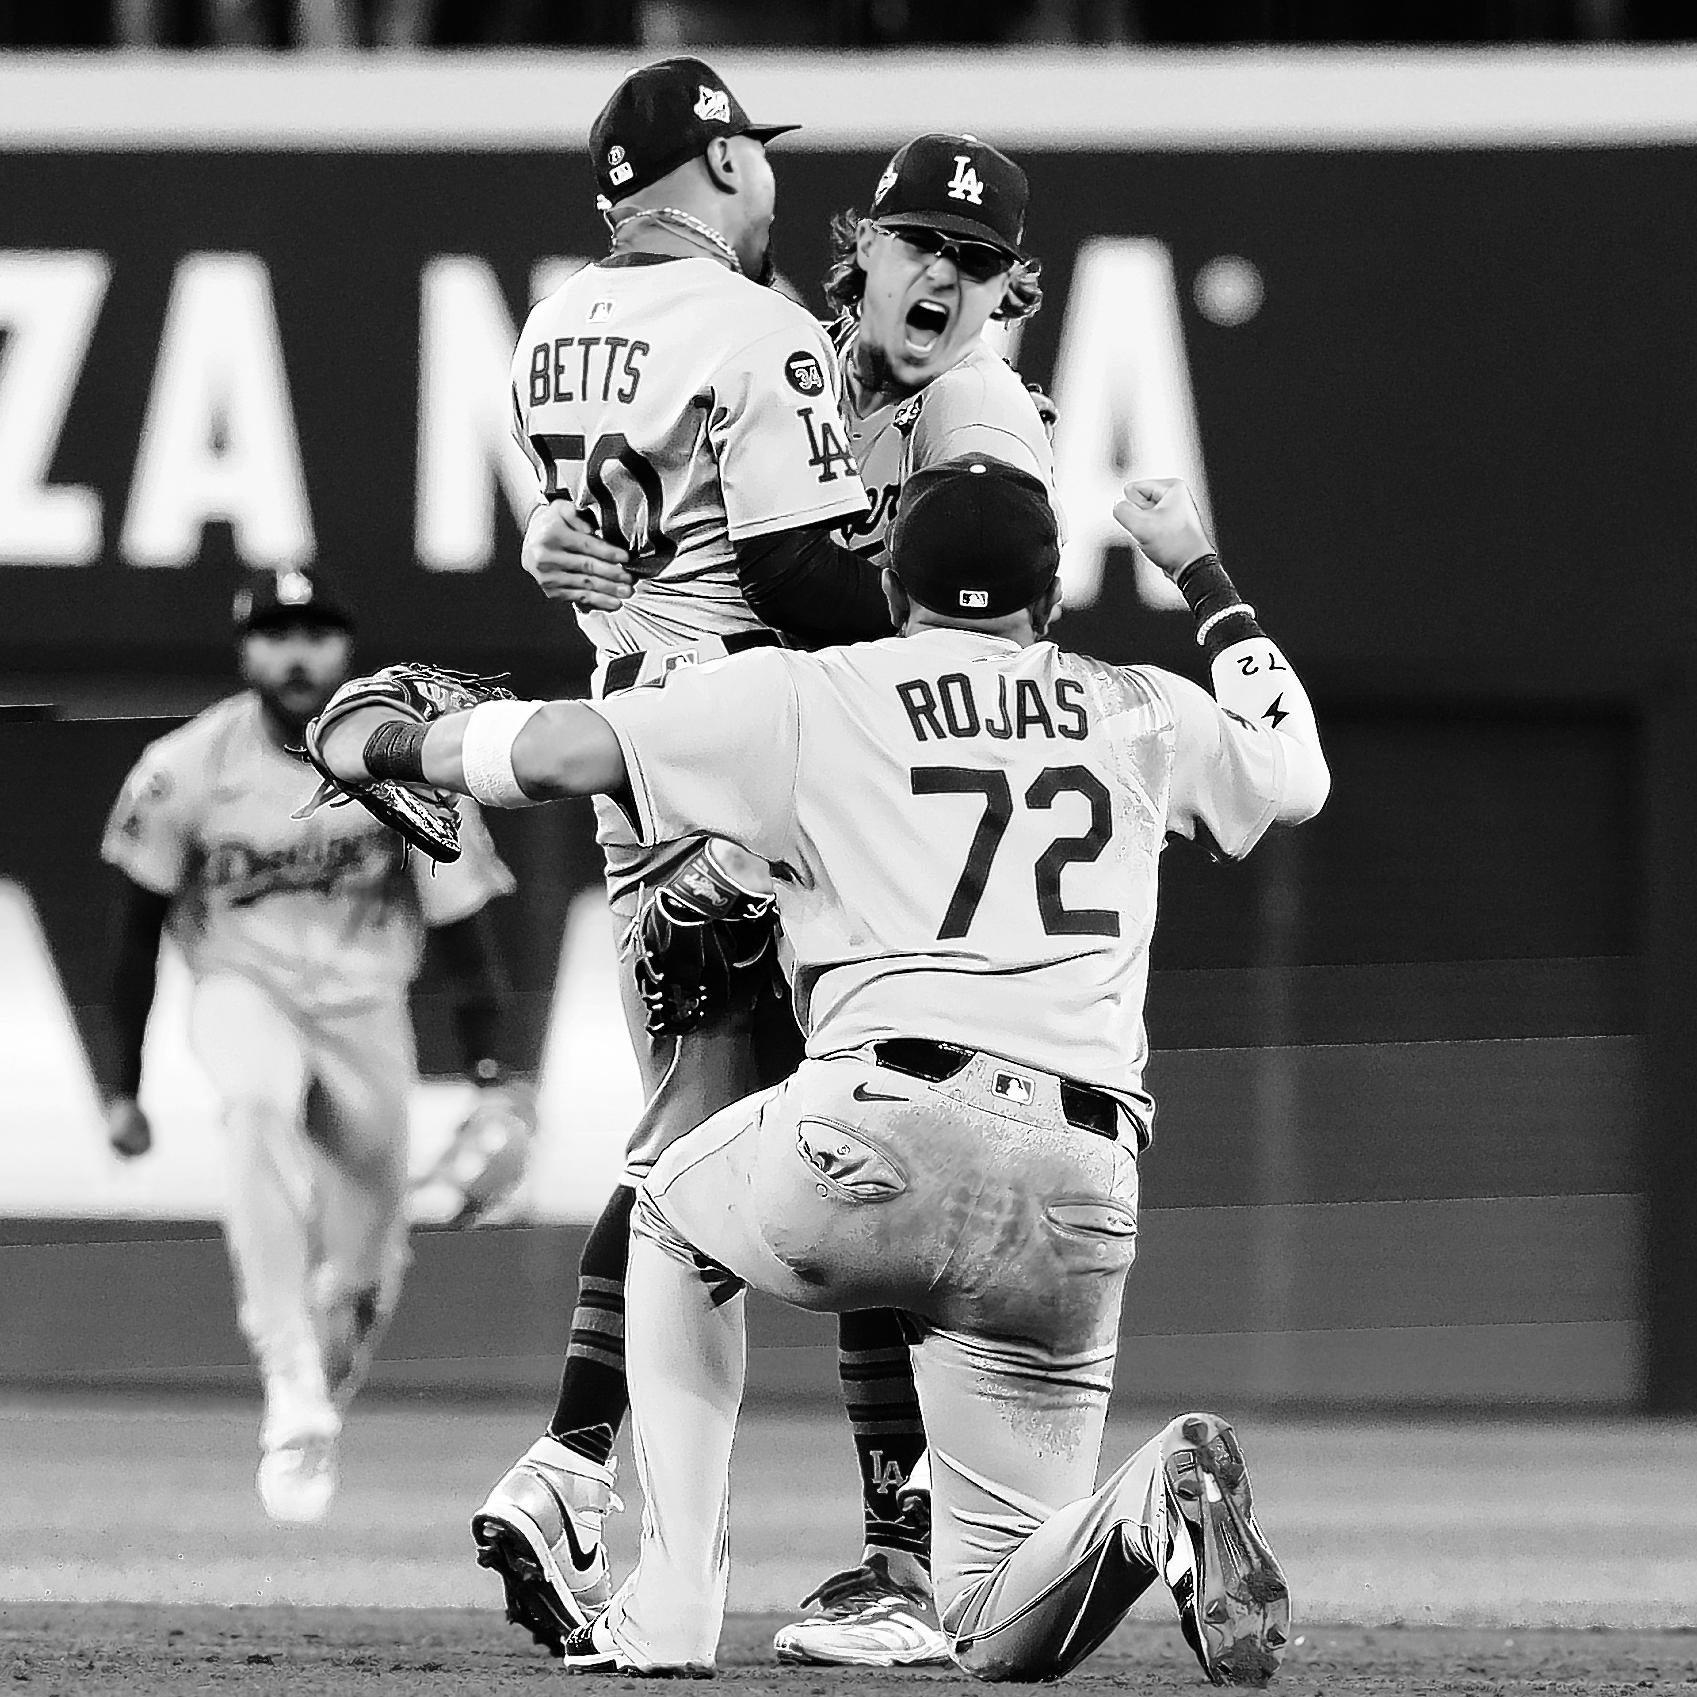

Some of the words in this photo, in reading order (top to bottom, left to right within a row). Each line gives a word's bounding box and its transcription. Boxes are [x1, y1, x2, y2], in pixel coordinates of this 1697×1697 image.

[947, 155, 984, 205] LA
[530, 336, 650, 408] BETTS
[794, 364, 823, 391] 34
[796, 407, 858, 483] LA
[1237, 652, 1287, 676] 72
[895, 672, 1089, 742] ROJAS
[910, 765, 1121, 941] 72
[869, 1450, 909, 1494] LA
